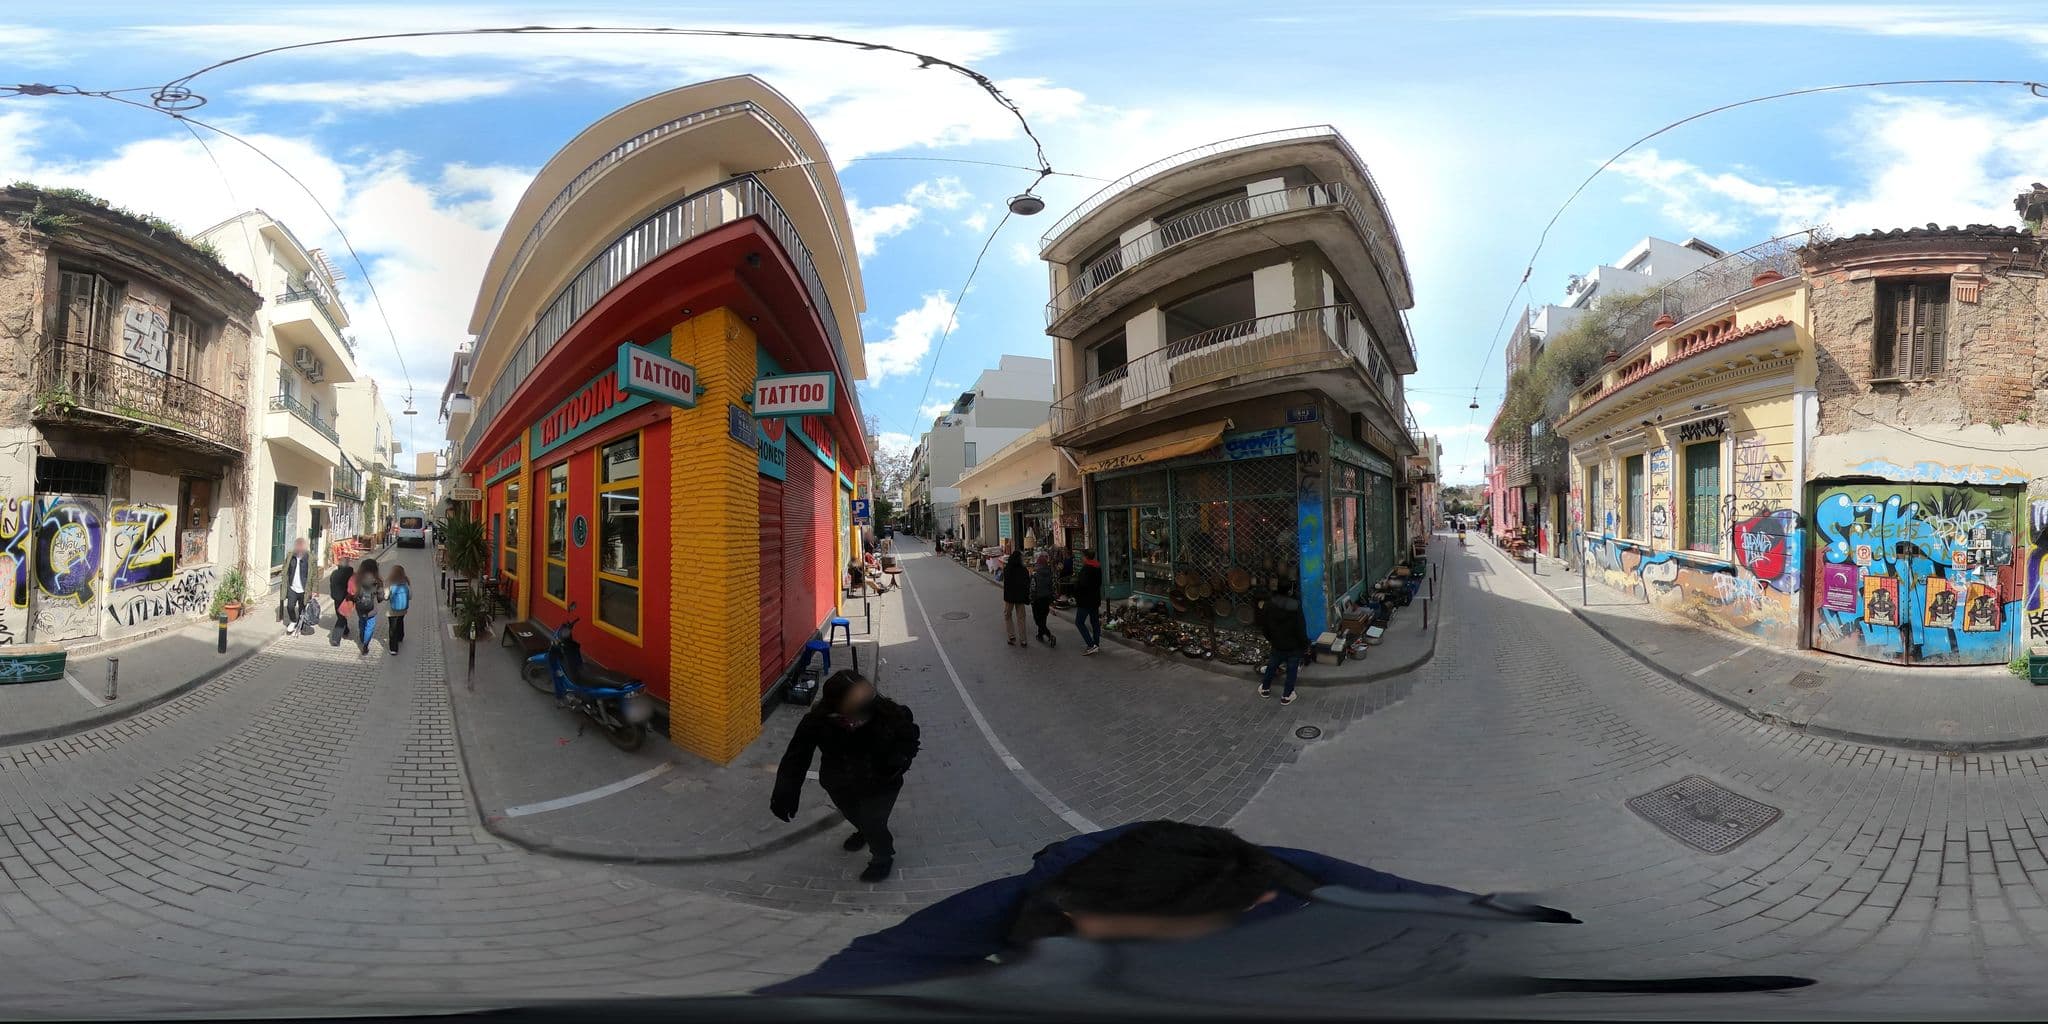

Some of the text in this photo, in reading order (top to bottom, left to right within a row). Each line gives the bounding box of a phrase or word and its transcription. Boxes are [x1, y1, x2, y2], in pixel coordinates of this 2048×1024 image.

[633, 356, 691, 395] TATTOO
[759, 383, 824, 405] TATTOO
[758, 438, 785, 467] HONEST
[855, 501, 865, 514] P
